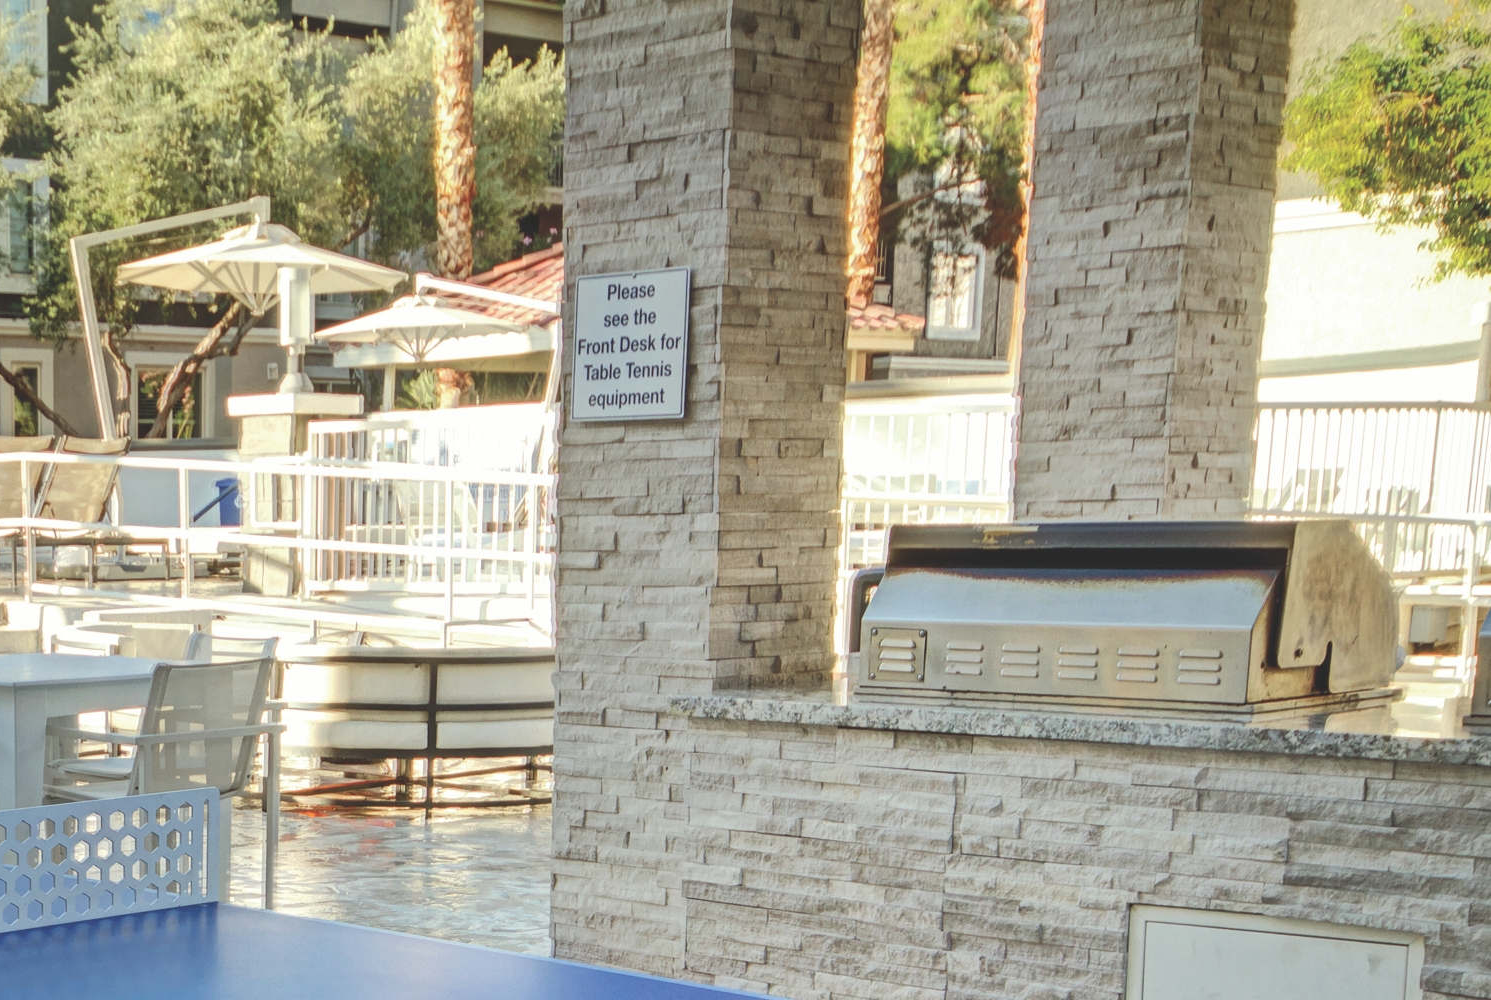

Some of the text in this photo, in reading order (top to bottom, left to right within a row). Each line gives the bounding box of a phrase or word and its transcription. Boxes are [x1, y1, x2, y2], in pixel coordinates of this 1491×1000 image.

[608, 284, 656, 301] Please
[604, 308, 656, 328] see the
[578, 333, 682, 355] Front Desk for
[584, 360, 672, 381] Table Tennis
[588, 388, 665, 410] equipment
